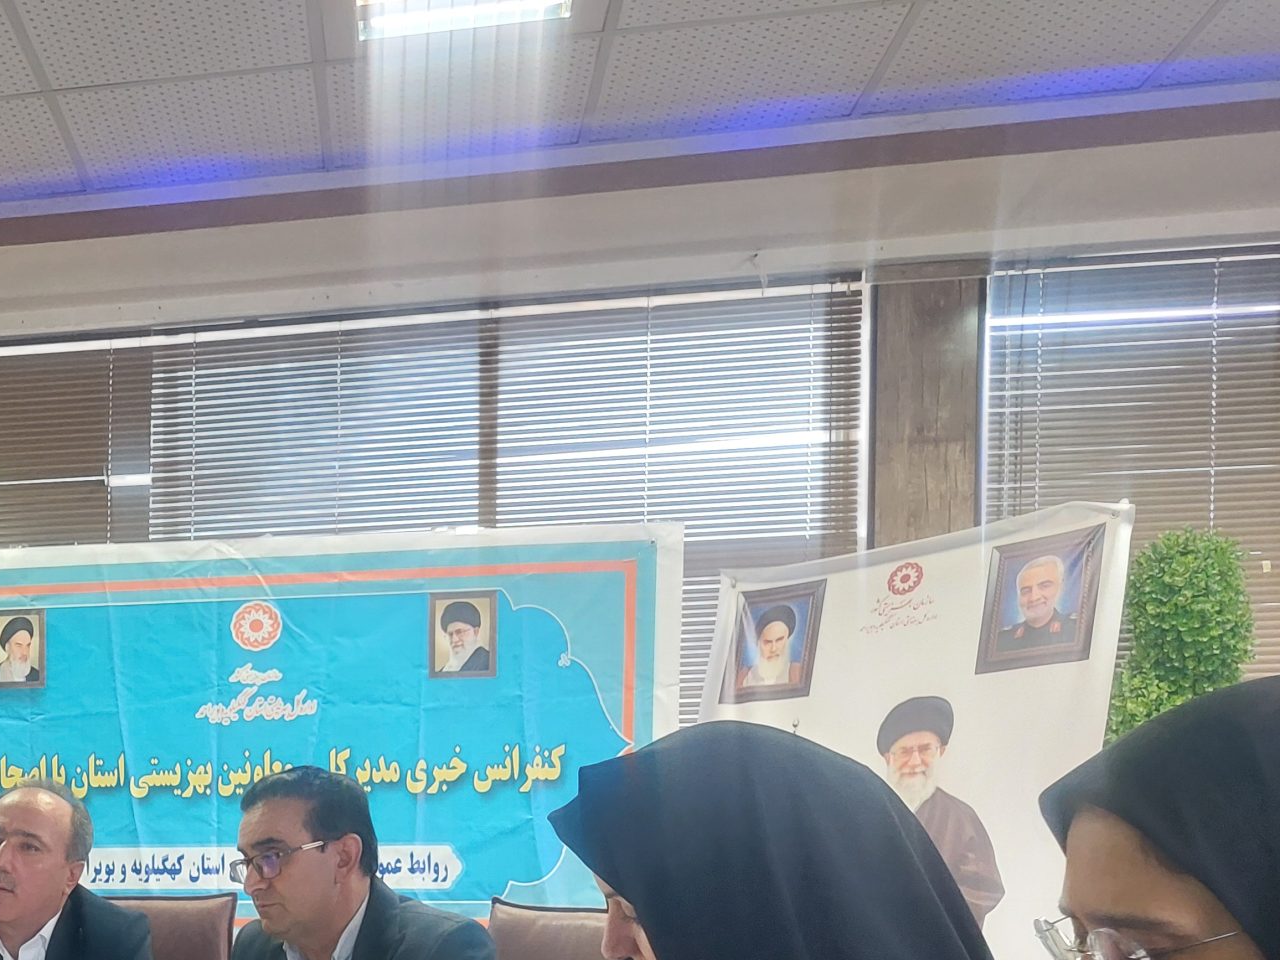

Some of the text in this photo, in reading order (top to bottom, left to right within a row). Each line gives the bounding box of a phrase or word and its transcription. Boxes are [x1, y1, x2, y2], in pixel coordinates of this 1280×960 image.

[71, 751, 125, 799] استان
[129, 757, 213, 798] بهزیستی
[355, 756, 401, 793] مدیر
[406, 745, 468, 794] خبری
[473, 743, 567, 793] کنفرانس
[85, 858, 116, 884] بویرا
[119, 866, 127, 884] و
[130, 853, 185, 884] کهگیلویه
[188, 853, 225, 883] استان
[406, 851, 449, 883] روابط
